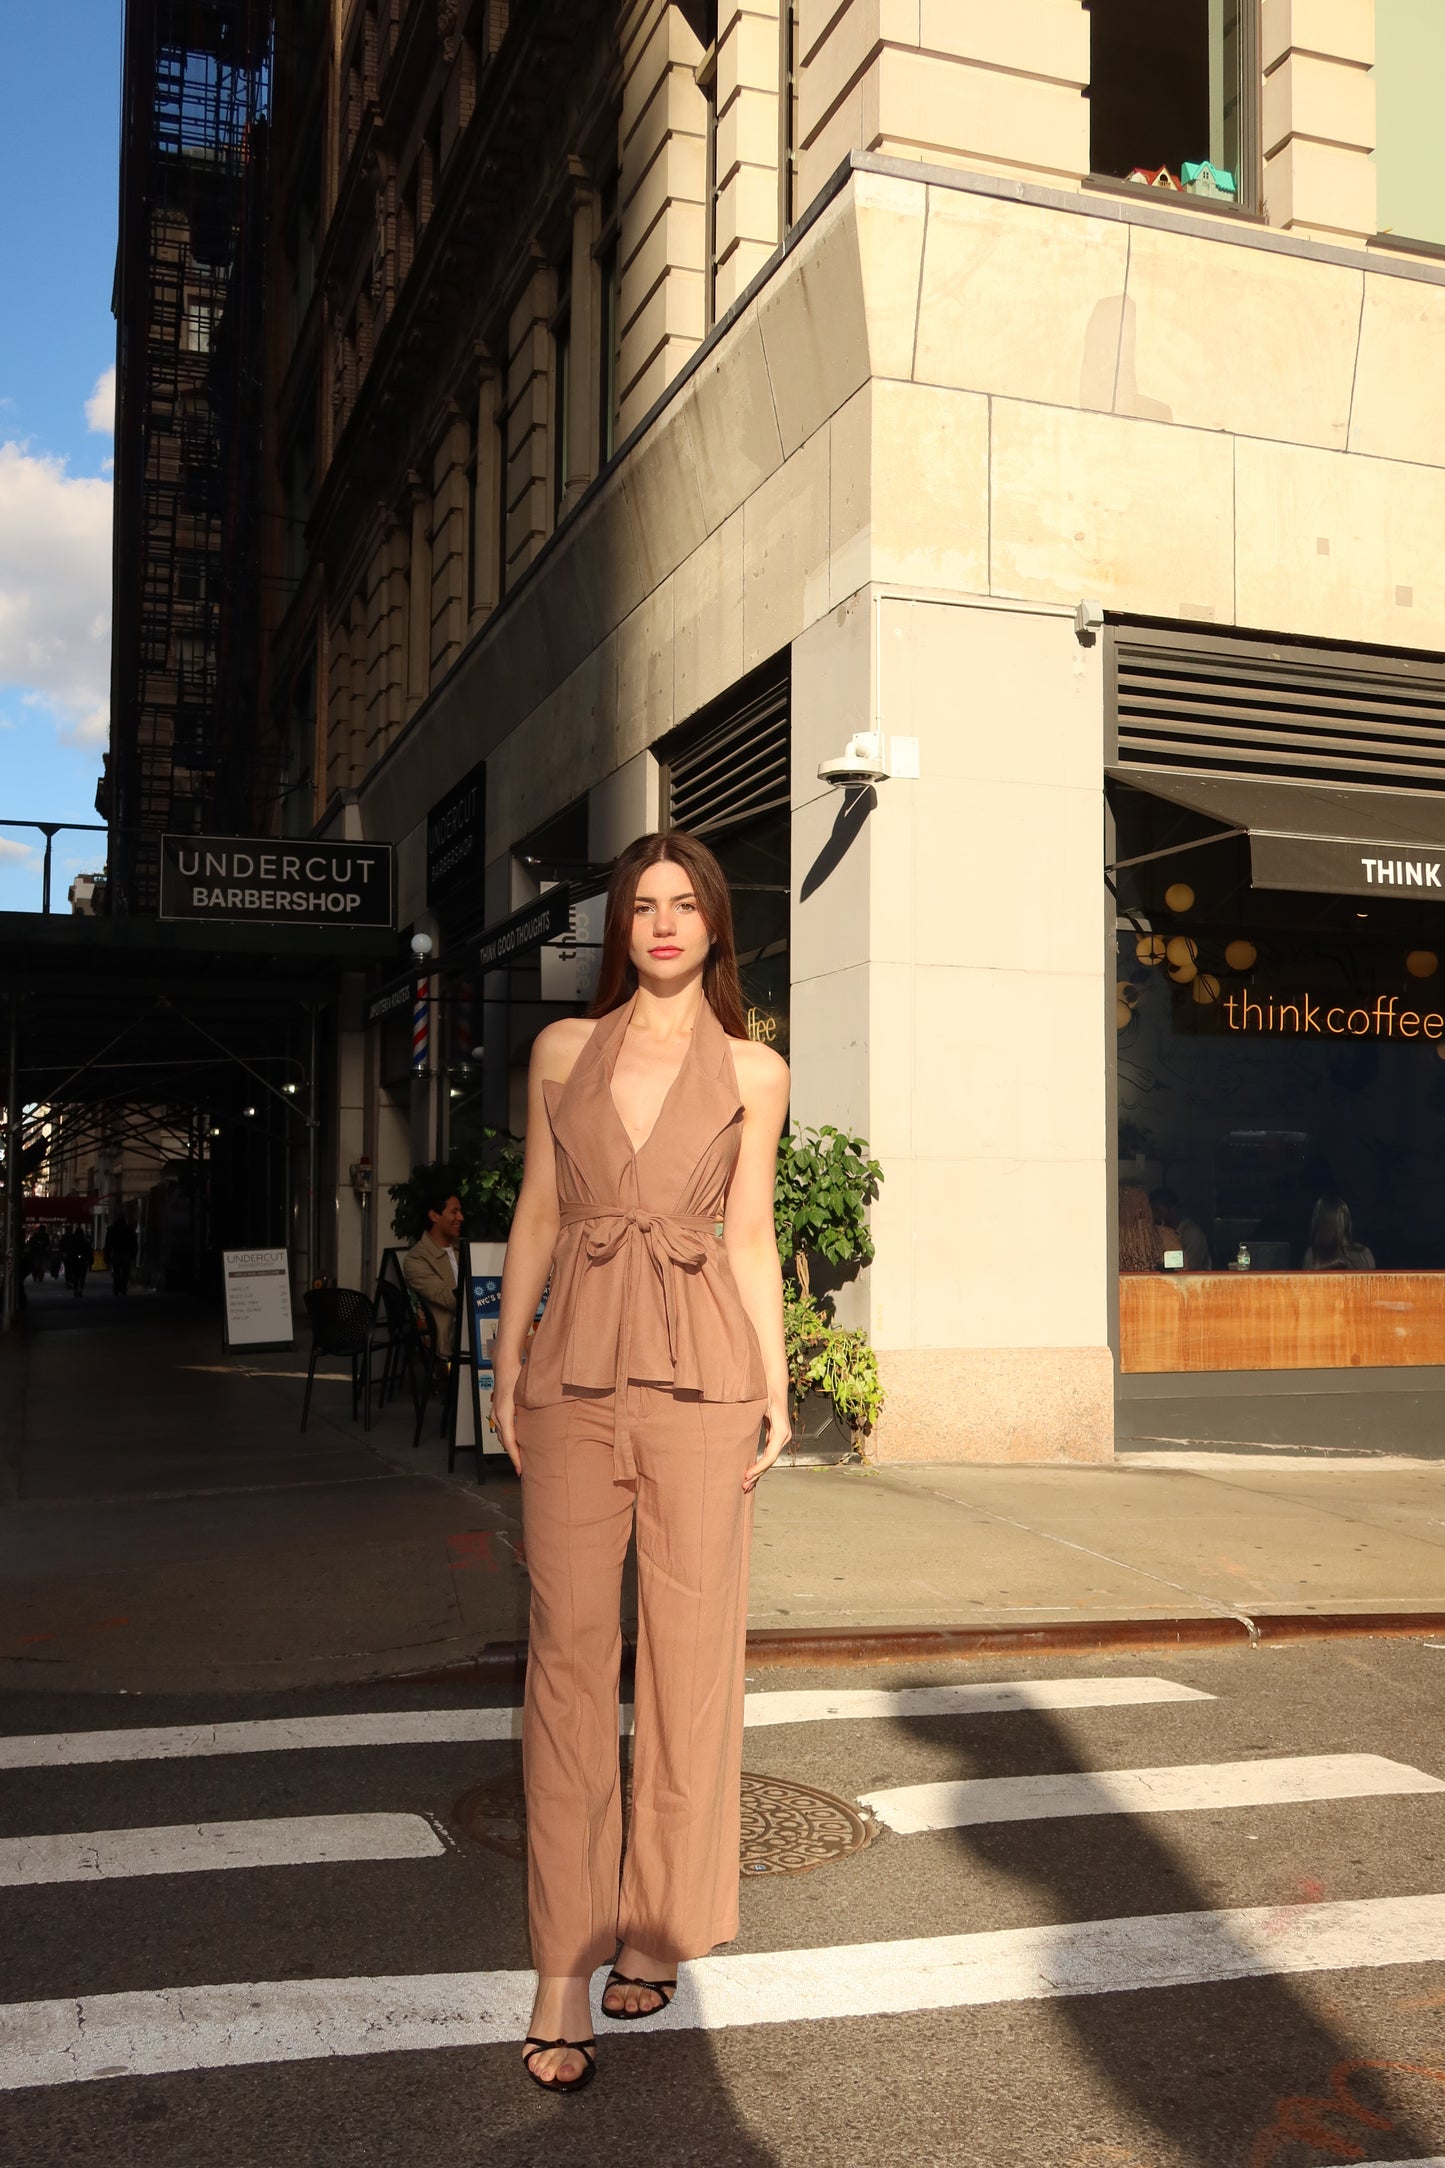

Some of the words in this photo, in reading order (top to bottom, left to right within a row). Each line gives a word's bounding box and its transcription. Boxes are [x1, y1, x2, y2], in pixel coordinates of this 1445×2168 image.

[430, 786, 478, 855] UNDERCUT
[178, 851, 375, 883] UNDERCUT
[1361, 858, 1442, 888] THINK
[192, 887, 361, 912] BARBERSHOP
[479, 941, 497, 966] THINK
[497, 929, 516, 957] GOOD
[516, 909, 551, 947] THOUGHTS
[226, 1252, 285, 1264] UNDERCUT
